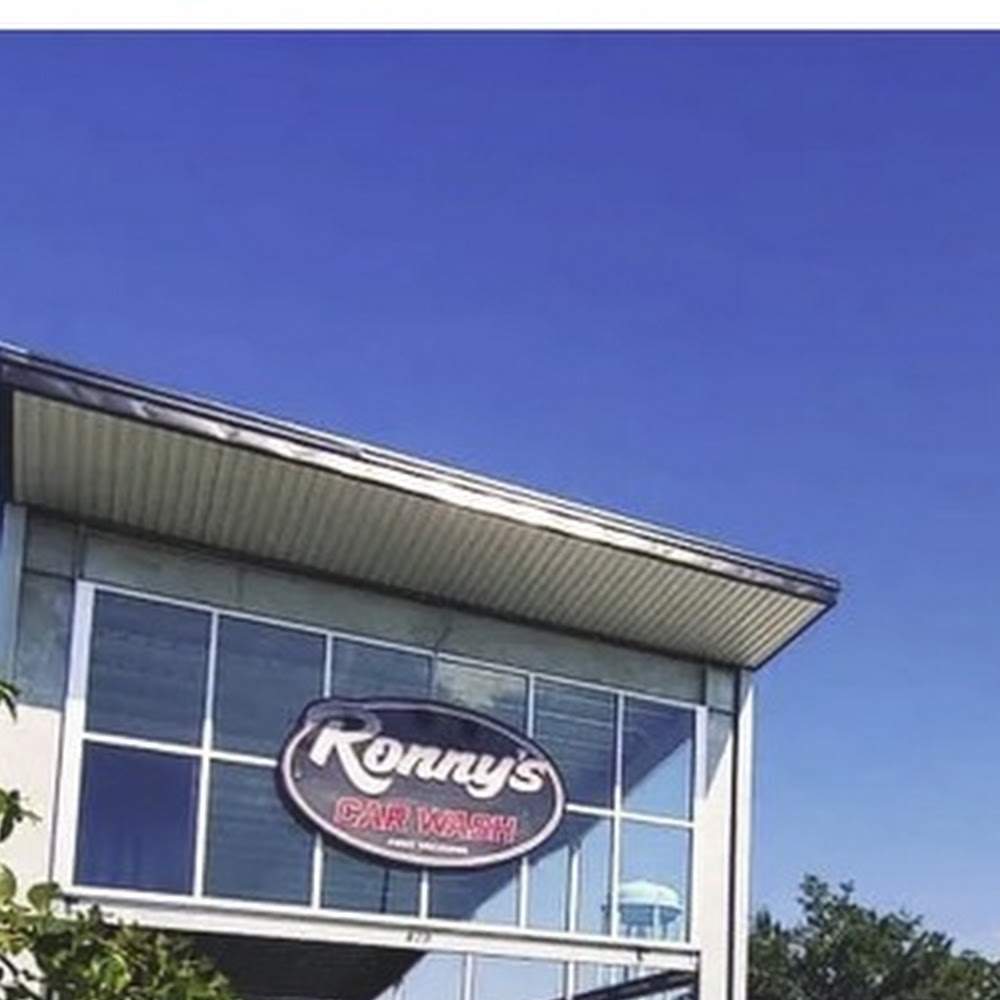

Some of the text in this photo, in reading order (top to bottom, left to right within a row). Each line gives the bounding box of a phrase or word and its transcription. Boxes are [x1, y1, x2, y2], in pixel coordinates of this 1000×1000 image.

[307, 708, 552, 798] Ronny's
[333, 796, 411, 833] CAR
[417, 806, 518, 846] WASH
